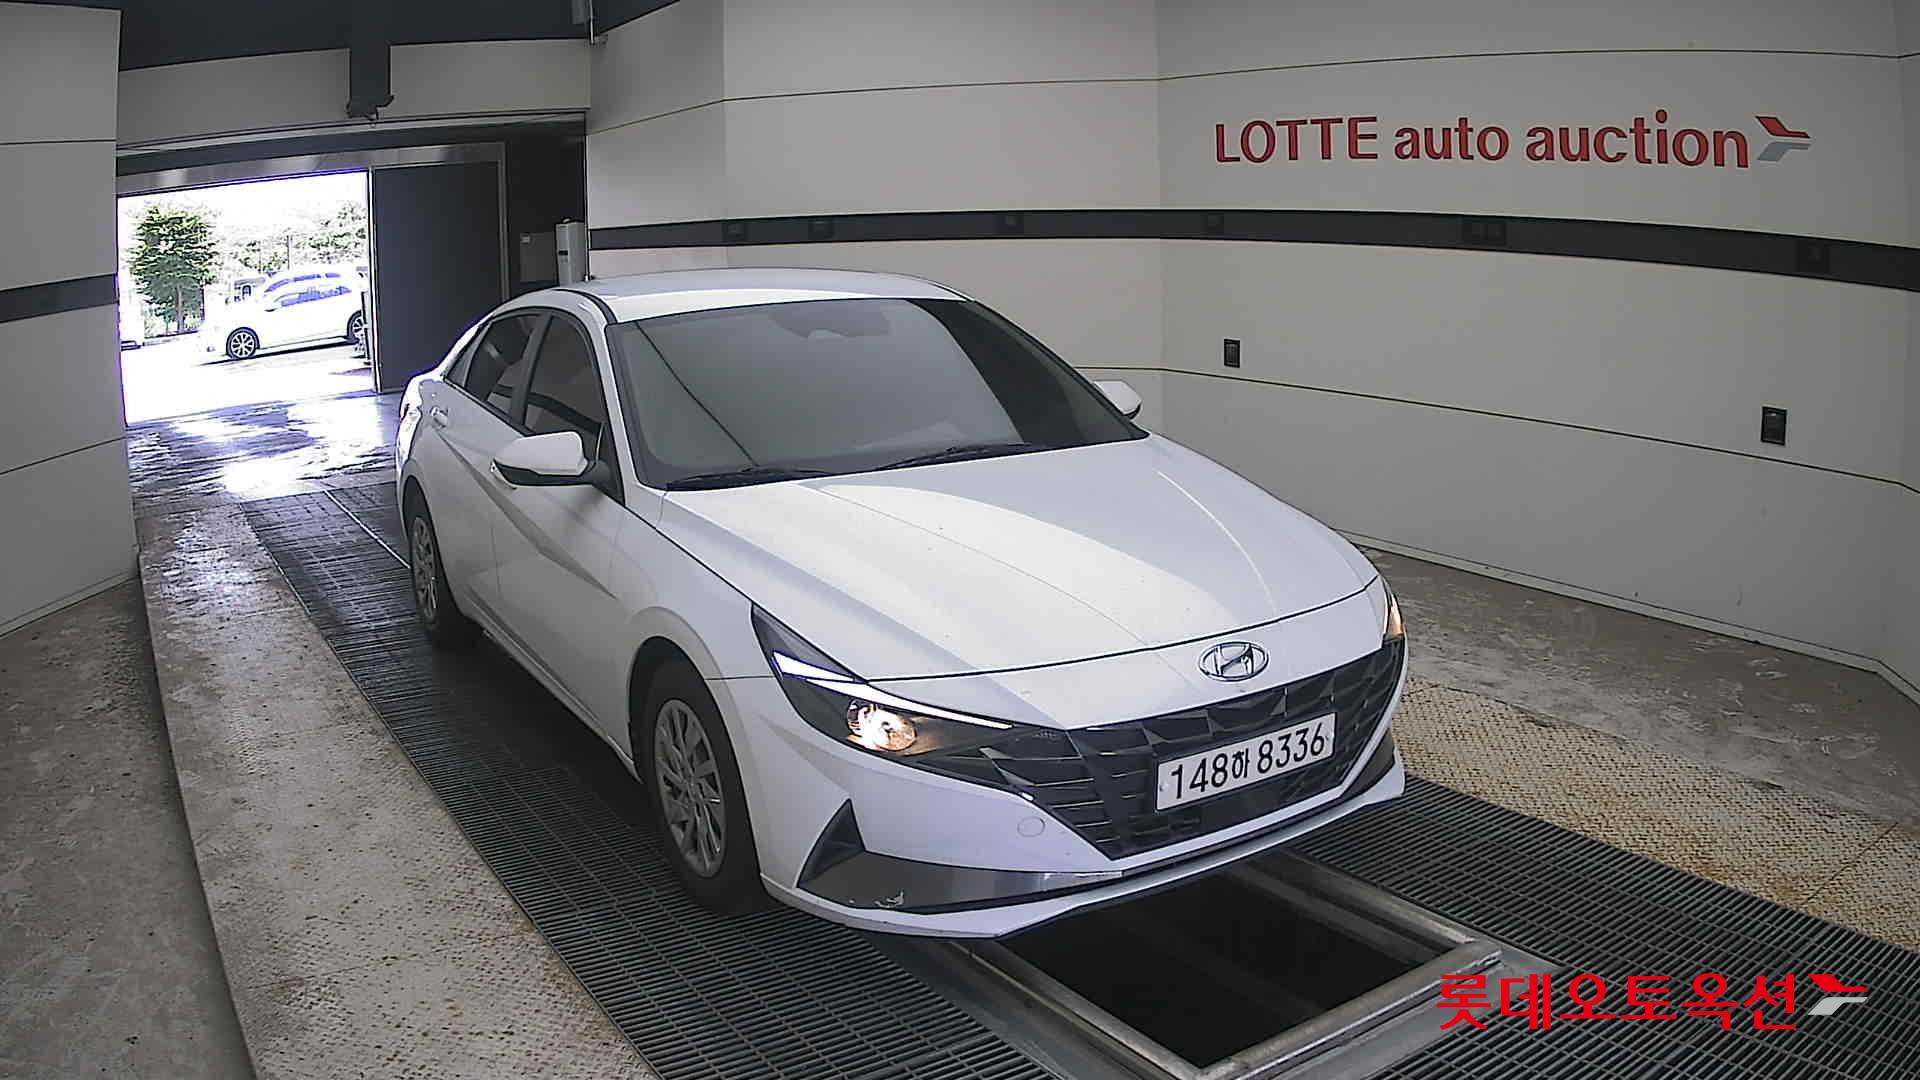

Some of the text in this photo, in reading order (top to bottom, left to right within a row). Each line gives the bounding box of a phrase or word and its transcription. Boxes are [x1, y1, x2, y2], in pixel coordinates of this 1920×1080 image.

[1215, 109, 1750, 169] LOTTE auto auction
[1171, 722, 1326, 800] 148하 8336
